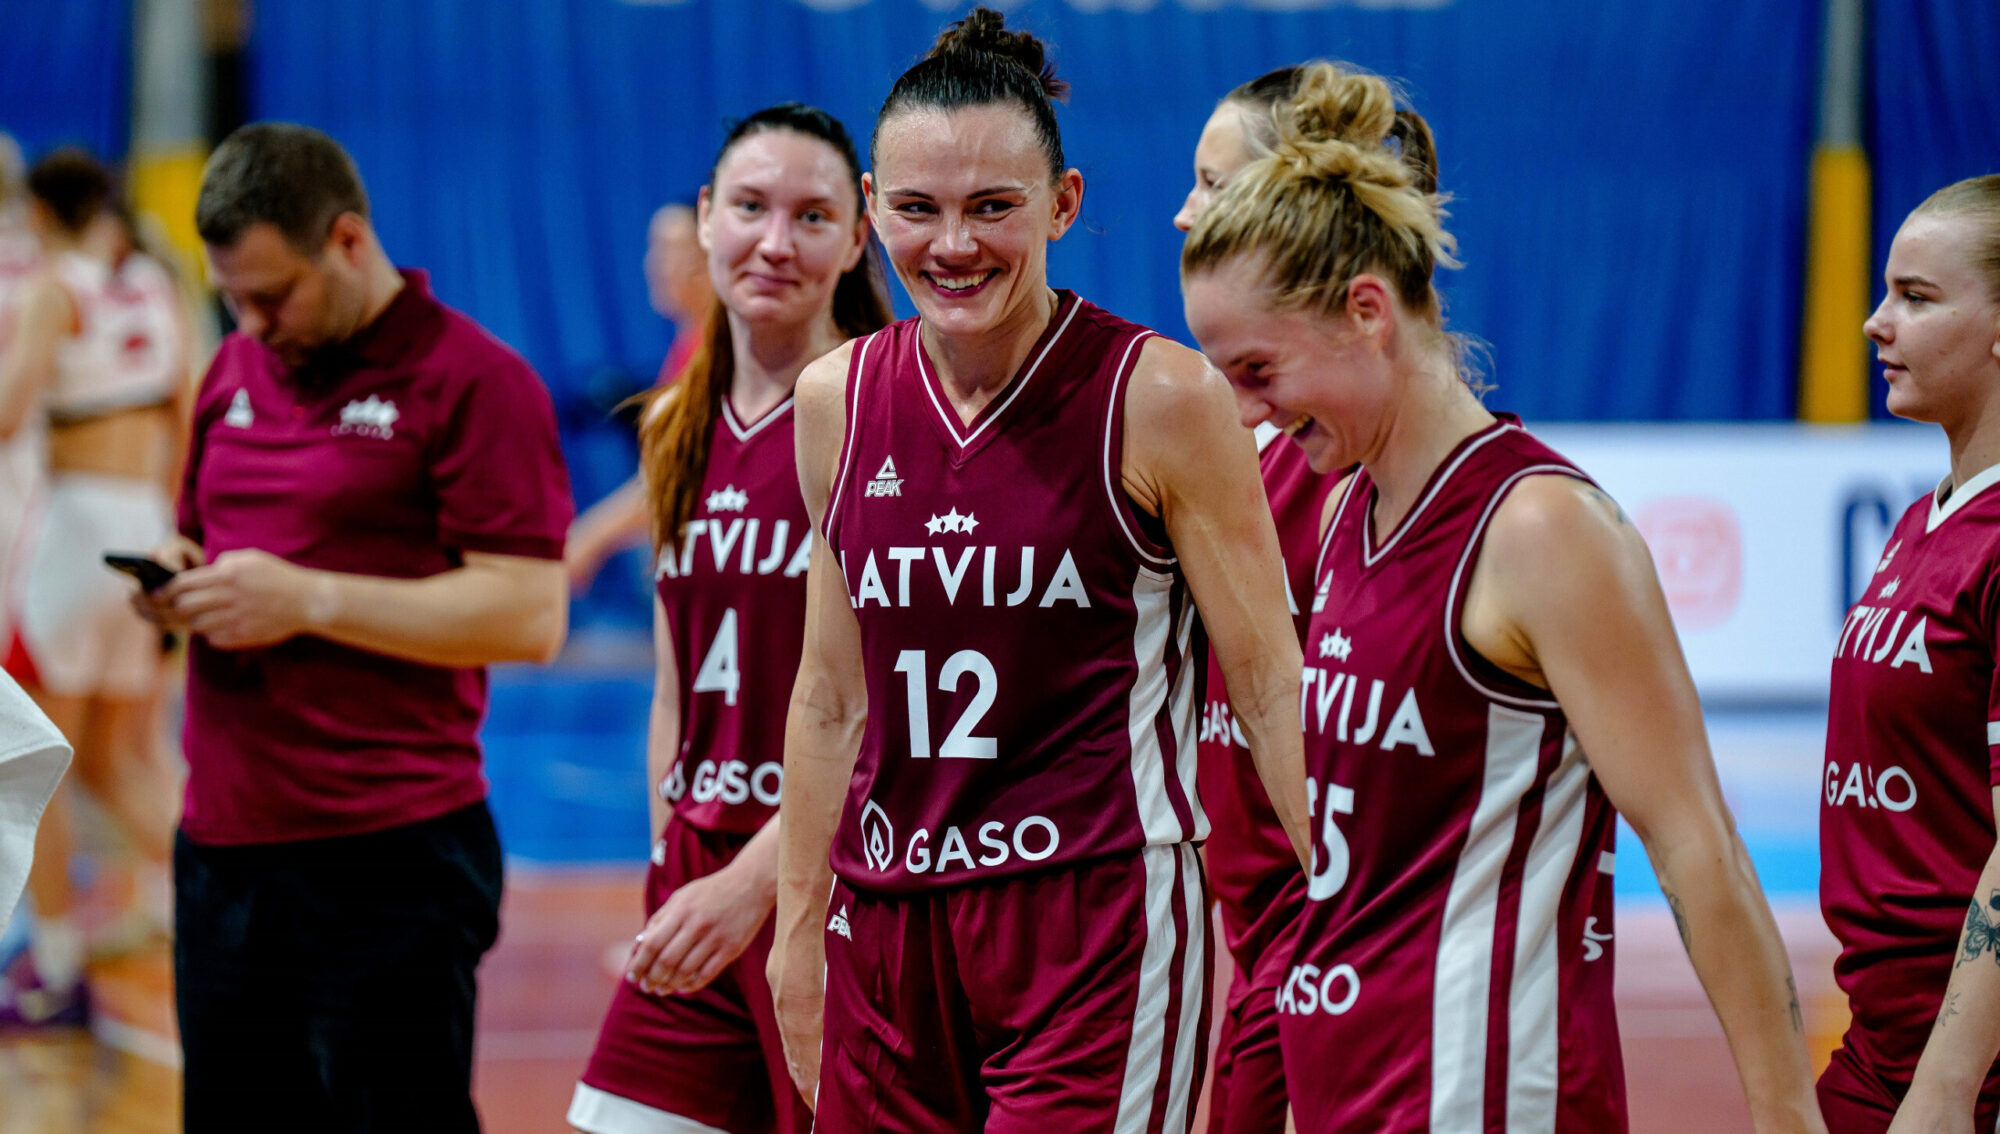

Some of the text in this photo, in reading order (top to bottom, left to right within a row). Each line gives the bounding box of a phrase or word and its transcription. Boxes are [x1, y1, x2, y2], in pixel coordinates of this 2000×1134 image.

[864, 479, 904, 497] PEAK
[655, 518, 813, 581] ATVIJA
[693, 608, 740, 706] 4
[894, 649, 998, 759] 12
[1301, 667, 1436, 757] TVIJA
[906, 815, 1060, 874] GASO
[1275, 963, 1361, 1016] ASO
